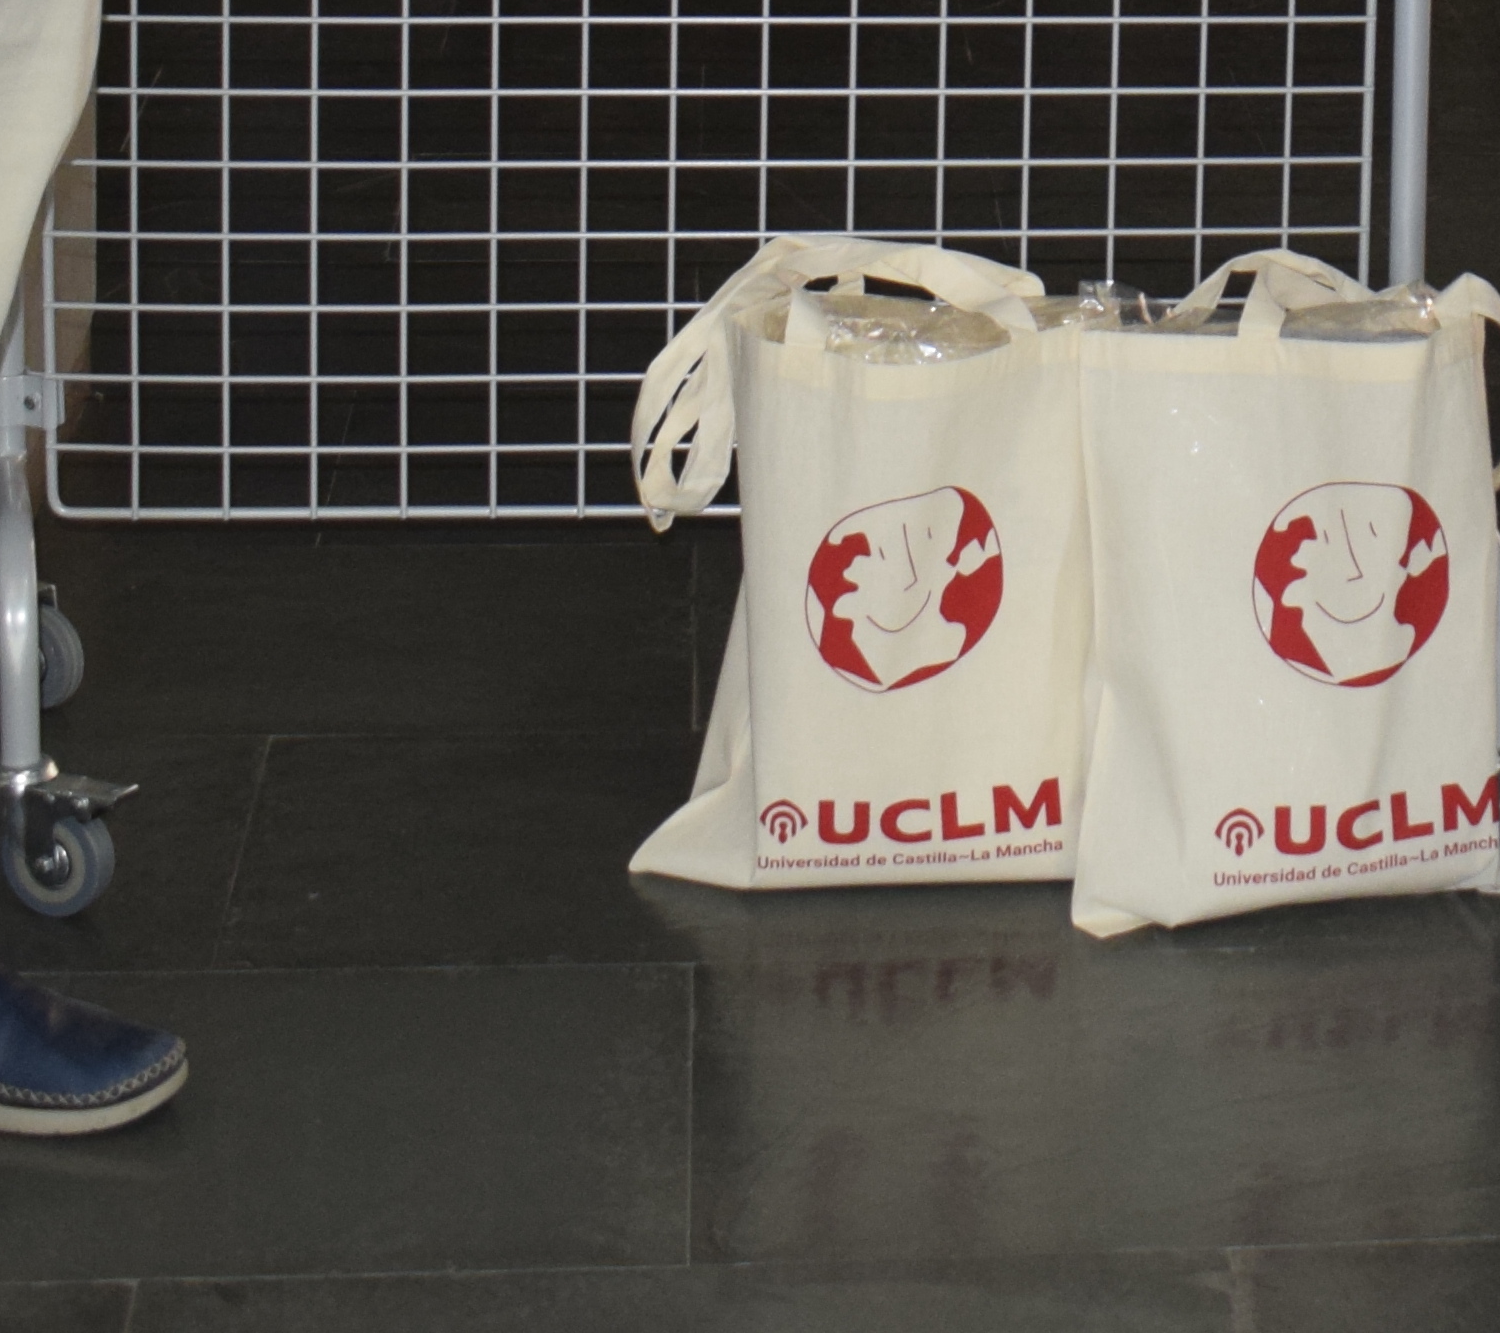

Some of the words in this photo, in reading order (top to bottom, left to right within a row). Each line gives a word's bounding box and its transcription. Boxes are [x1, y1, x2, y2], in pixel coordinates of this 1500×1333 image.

[818, 776, 1063, 845] UCLM
[1274, 775, 1500, 856] UCLM
[757, 854, 861, 870] Universidad
[866, 852, 888, 867] de
[996, 838, 1063, 858] Mancha
[1213, 866, 1316, 887] Universidad
[1321, 864, 1342, 879] de
[1444, 835, 1500, 857] Manch
